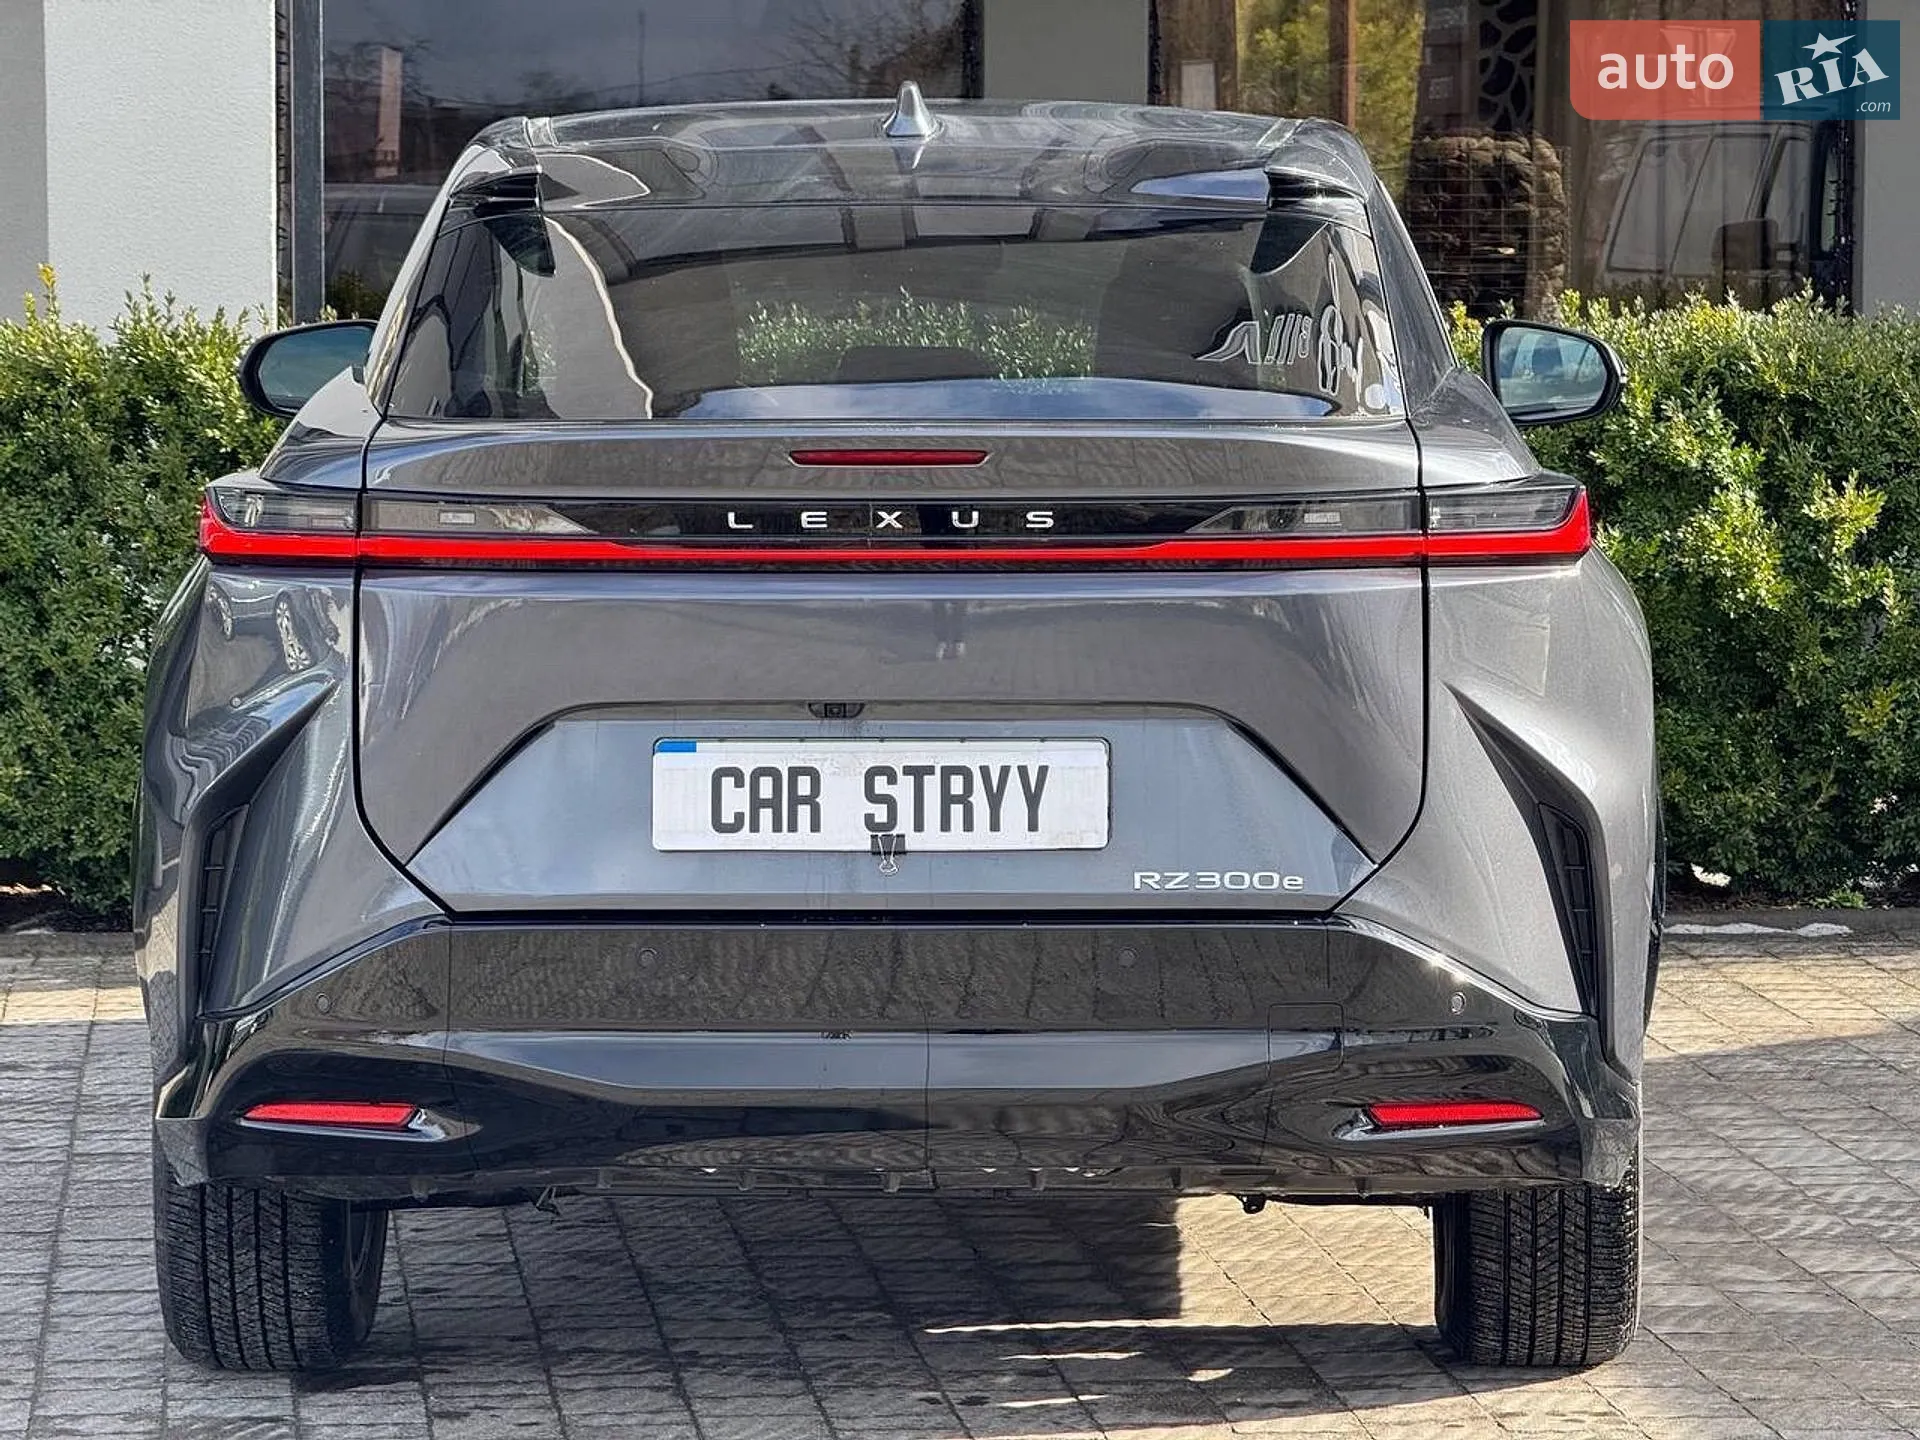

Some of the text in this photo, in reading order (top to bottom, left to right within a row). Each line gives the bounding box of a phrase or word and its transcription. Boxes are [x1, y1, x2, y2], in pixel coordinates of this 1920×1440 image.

[727, 511, 1054, 528] LEXUS
[711, 765, 1049, 834] CAR STRYY
